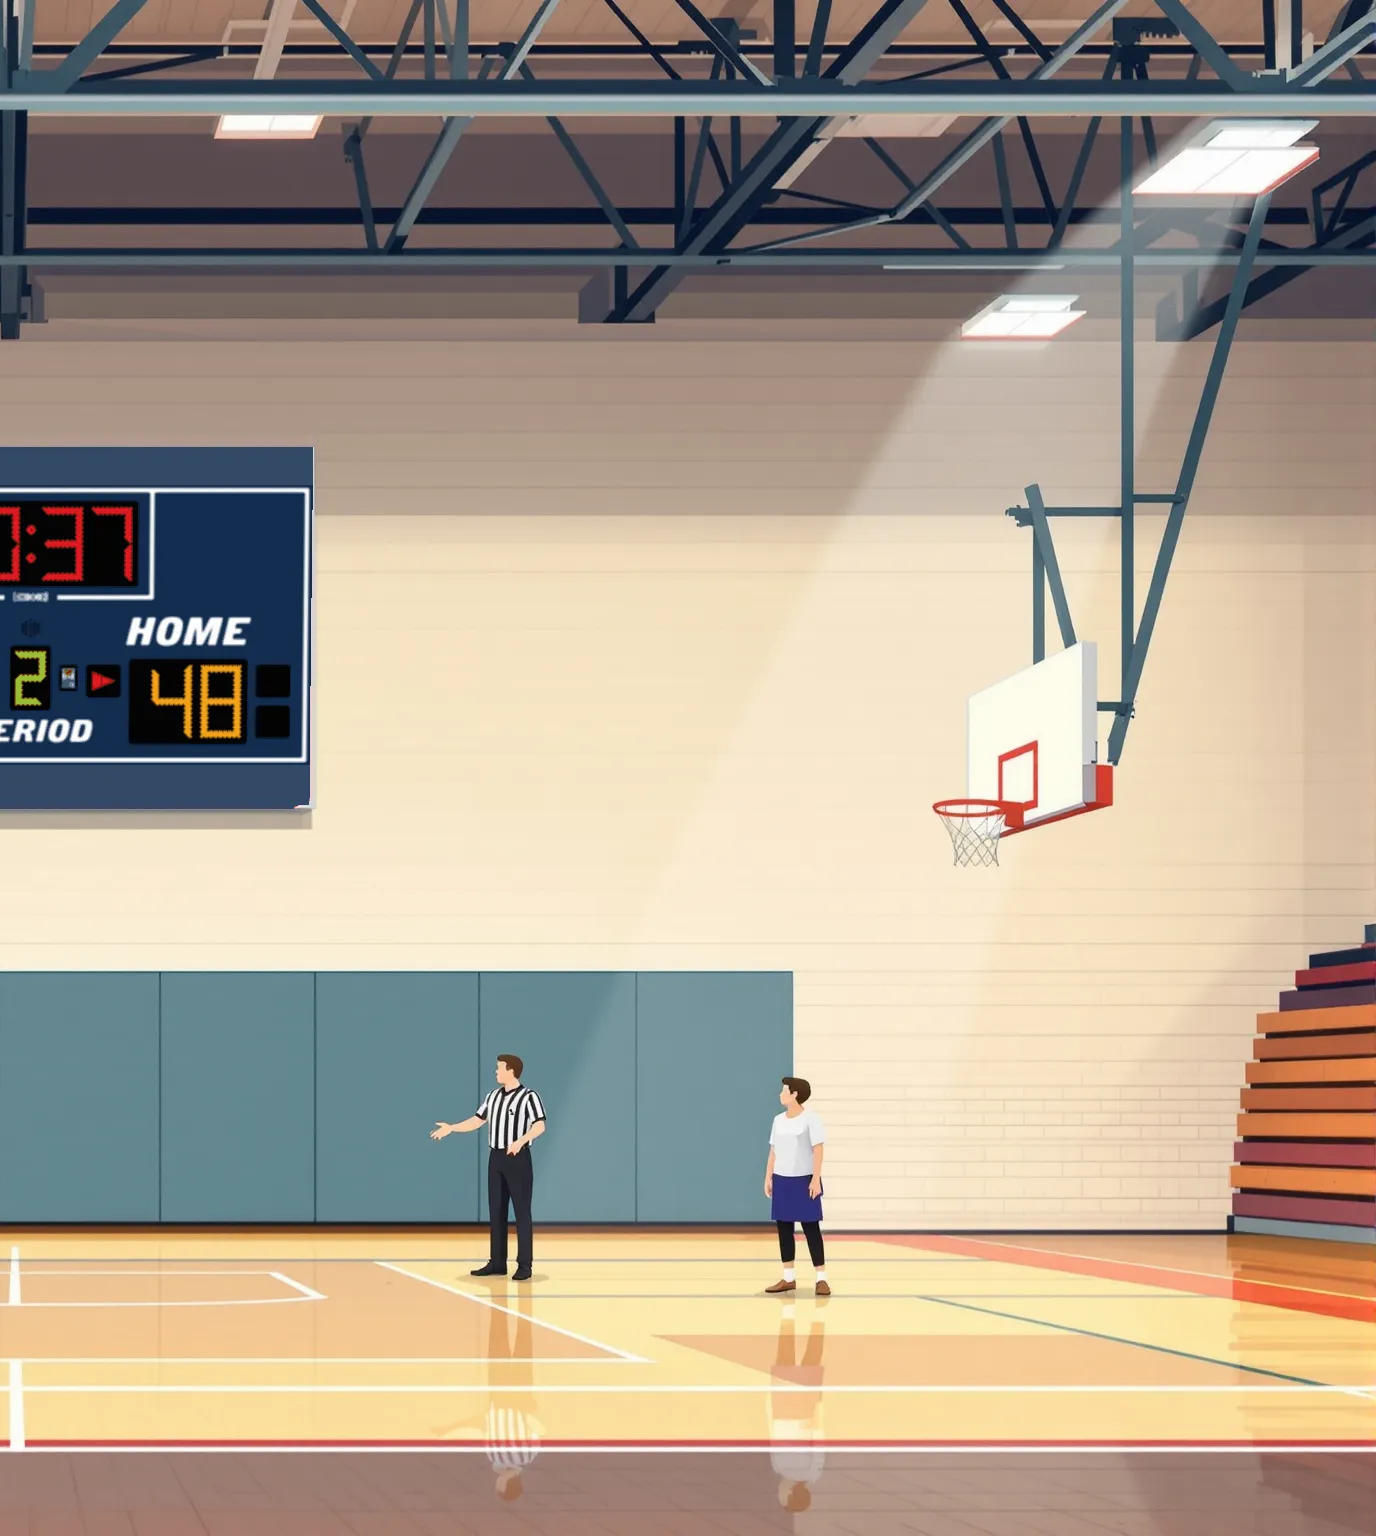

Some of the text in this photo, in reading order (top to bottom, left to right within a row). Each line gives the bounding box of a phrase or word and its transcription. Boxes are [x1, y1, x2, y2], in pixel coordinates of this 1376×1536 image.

[126, 617, 252, 646] HOME
[15, 651, 46, 705] 2
[151, 665, 242, 738] 48
